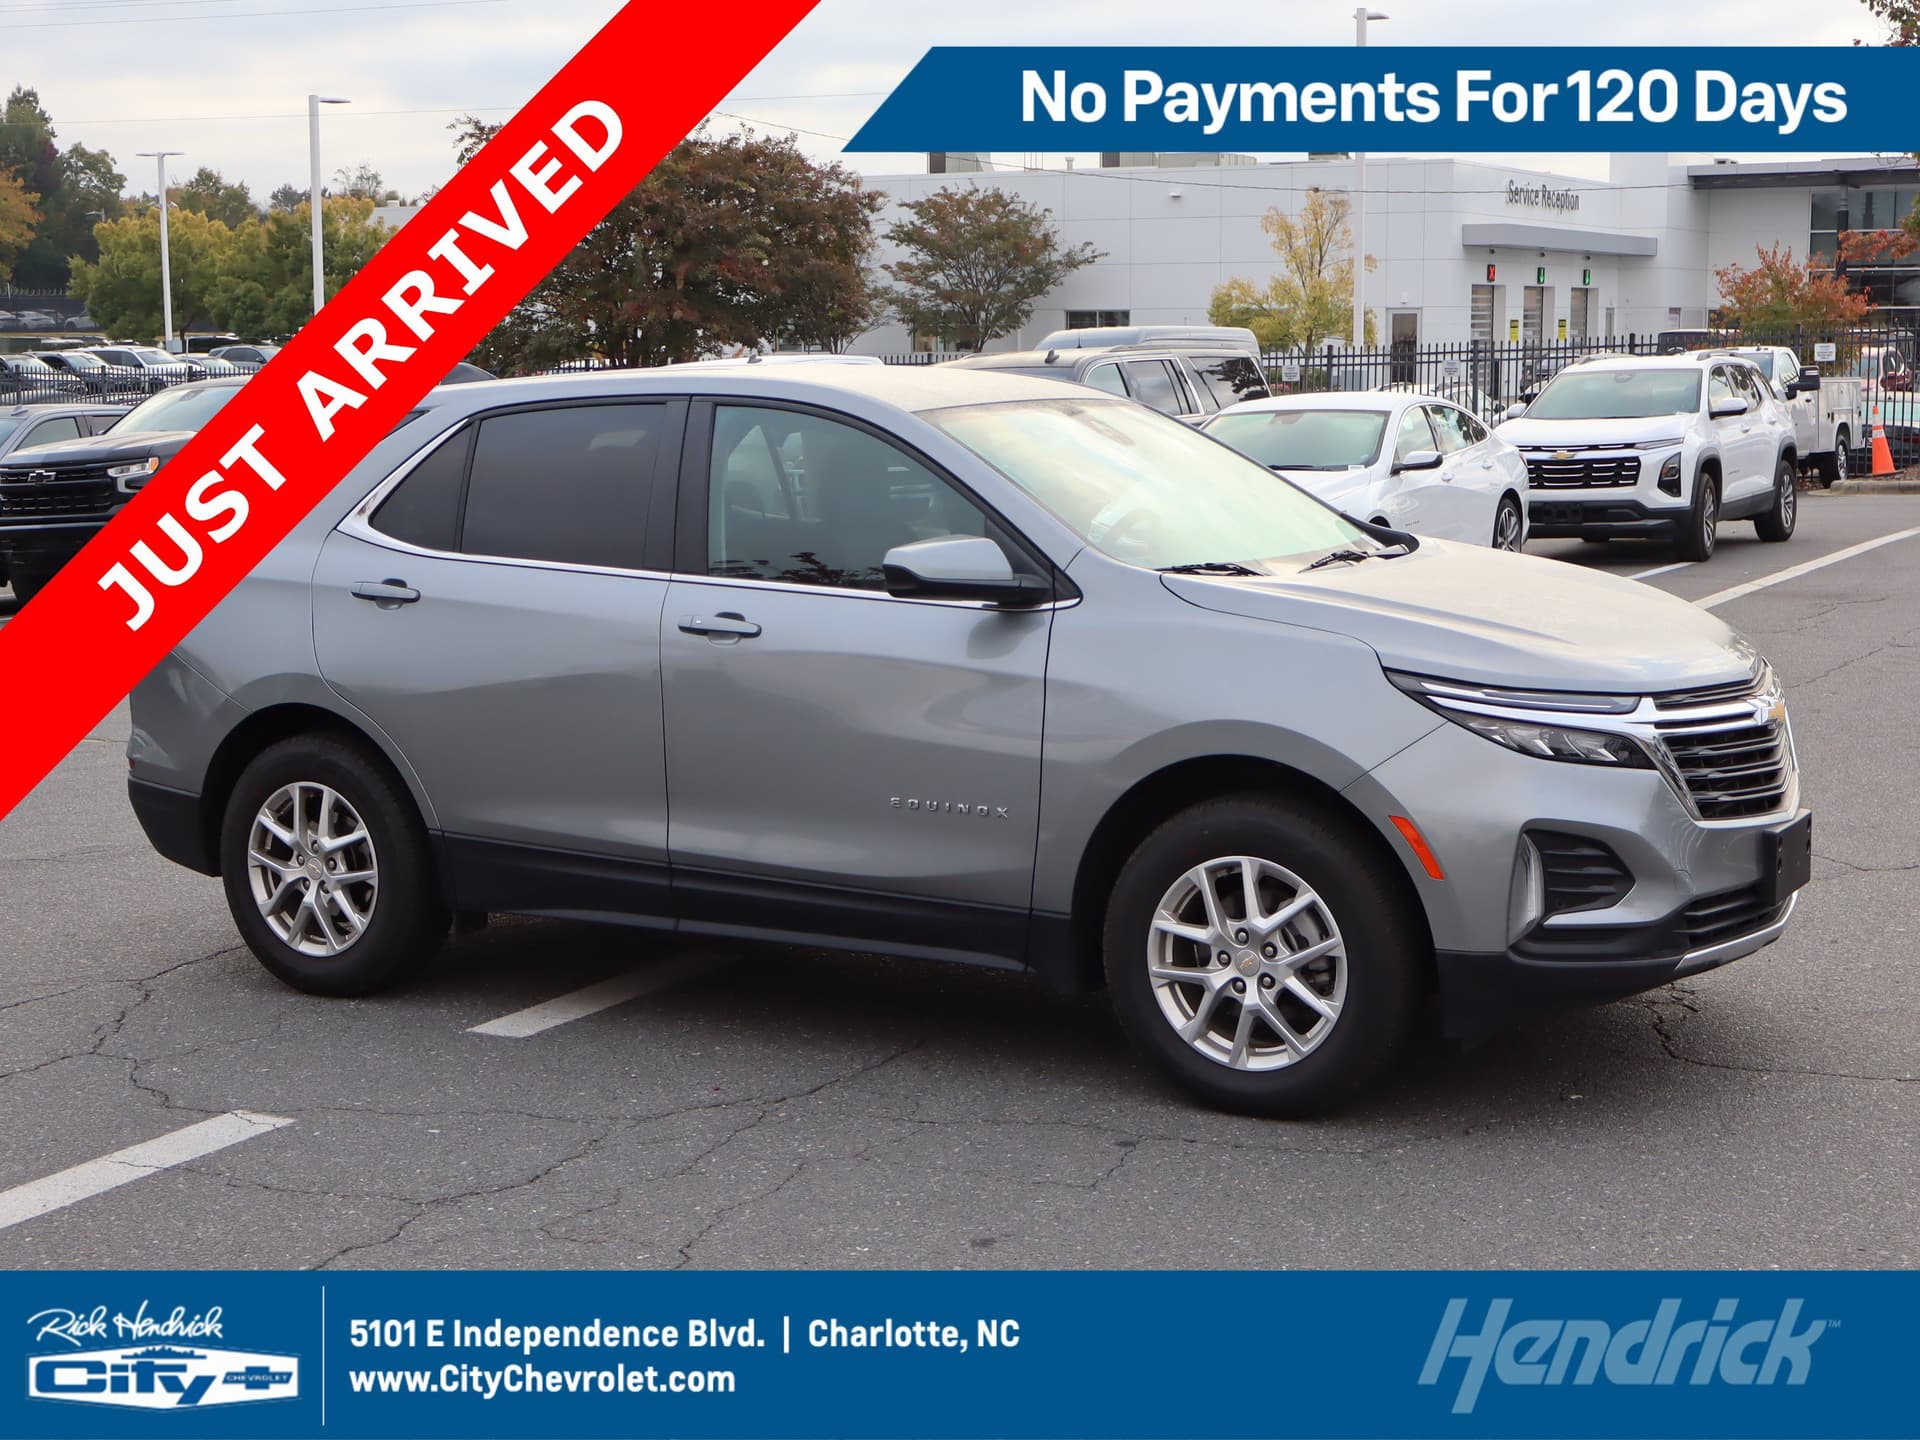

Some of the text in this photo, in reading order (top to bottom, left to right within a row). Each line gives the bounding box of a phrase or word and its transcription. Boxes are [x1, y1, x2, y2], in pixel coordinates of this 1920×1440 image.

[1507, 179, 1580, 214] Service Reception
[890, 797, 1009, 819] EQUINOX
